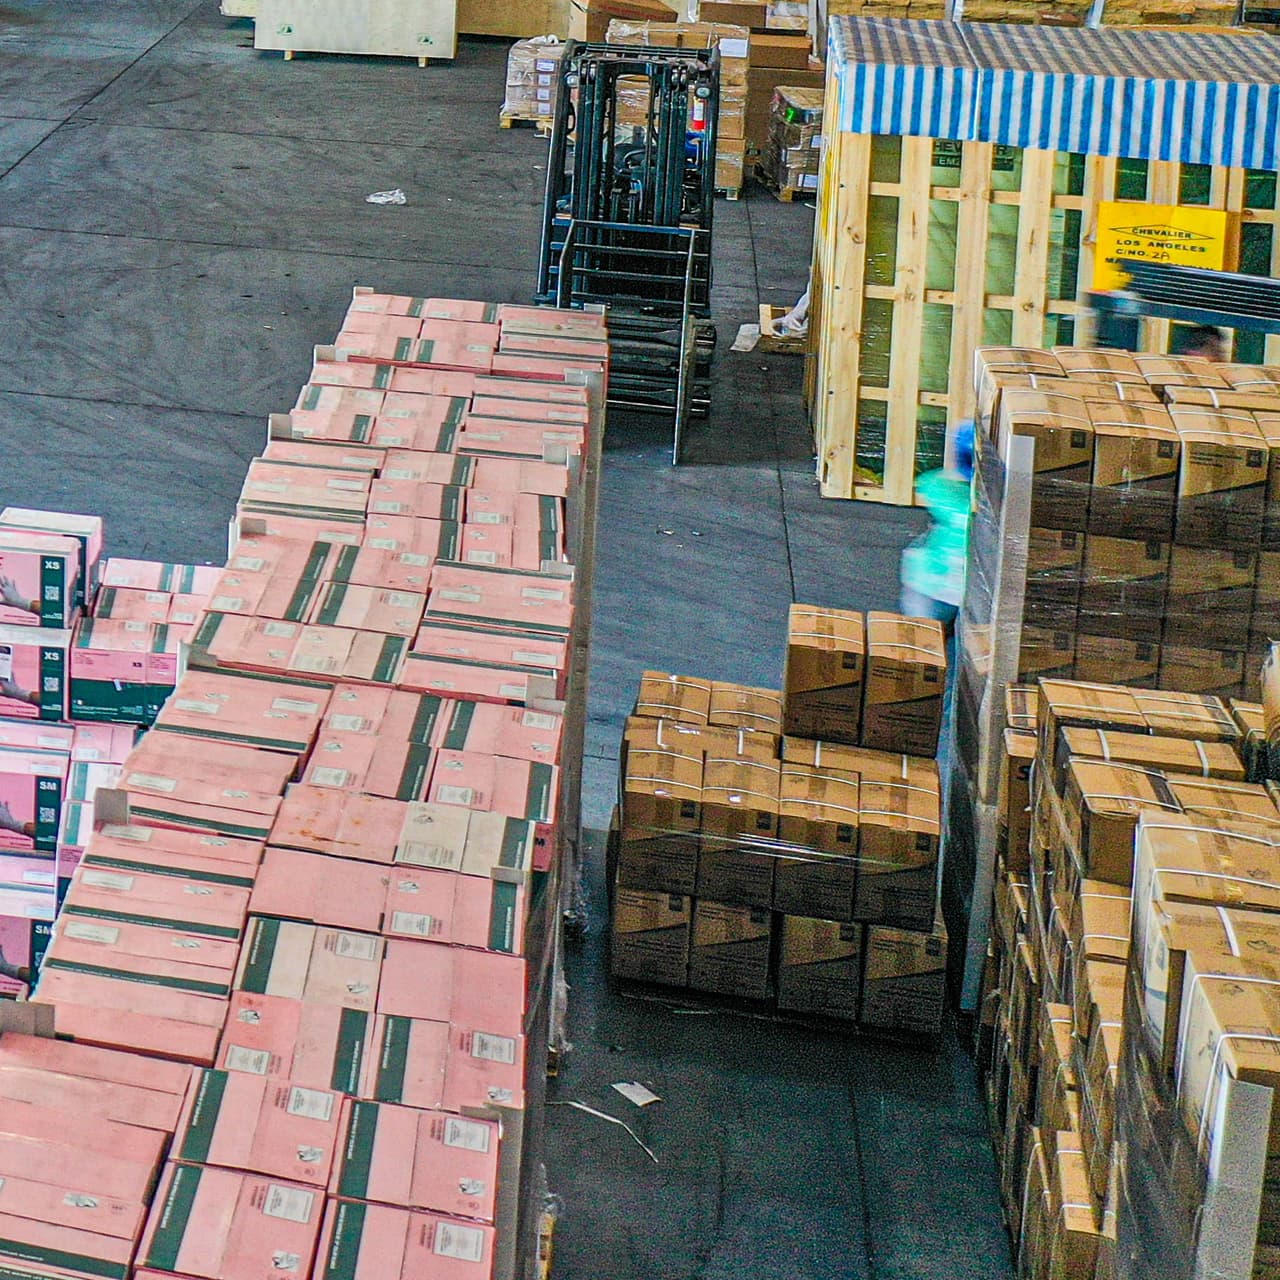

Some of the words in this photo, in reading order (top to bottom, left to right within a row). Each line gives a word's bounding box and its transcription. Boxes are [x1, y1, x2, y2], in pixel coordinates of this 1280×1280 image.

[1132, 227, 1192, 239] CHEVALIER
[1147, 242, 1205, 252] ANGELES
[45, 561, 60, 570] XS
[44, 652, 59, 661] XS
[40, 781, 56, 790] SM
